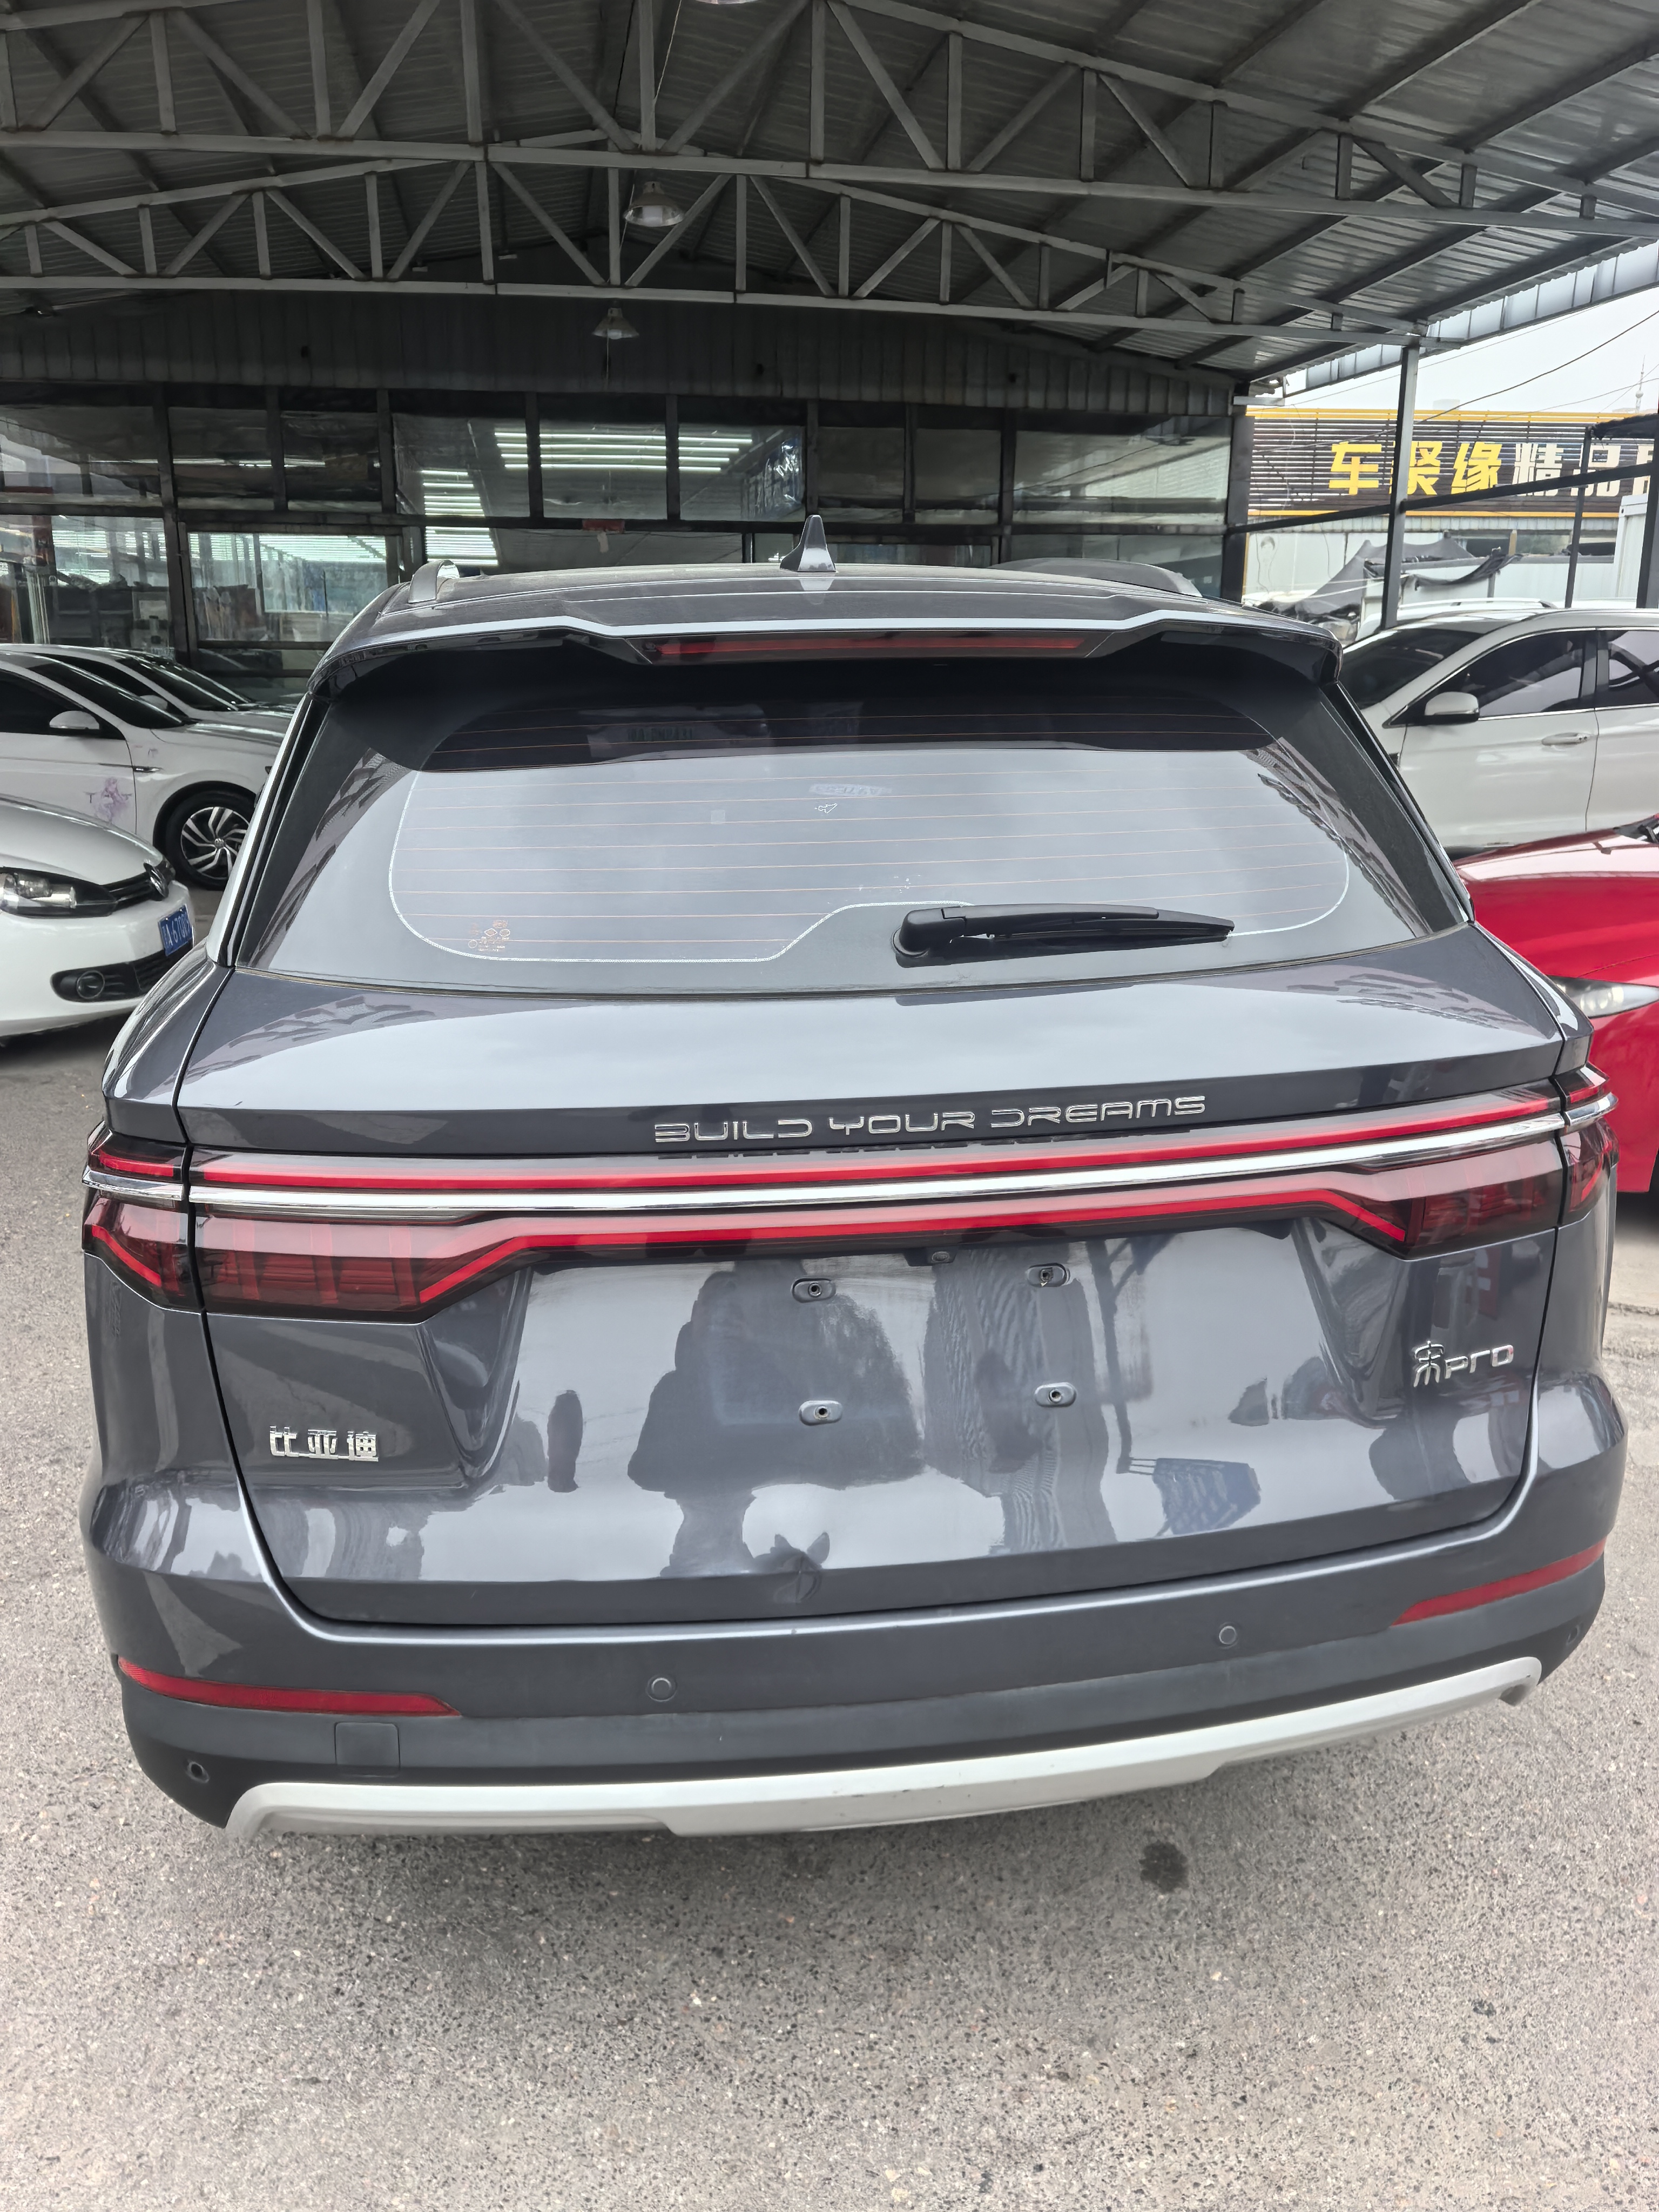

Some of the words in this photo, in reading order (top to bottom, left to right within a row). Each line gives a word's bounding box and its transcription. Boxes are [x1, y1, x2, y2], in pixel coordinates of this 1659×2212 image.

[655, 1119, 813, 1142] BUILD
[829, 1111, 975, 1135] YOUR
[990, 1096, 1205, 1128] DREAMS
[269, 1426, 379, 1462] 比亚迪
